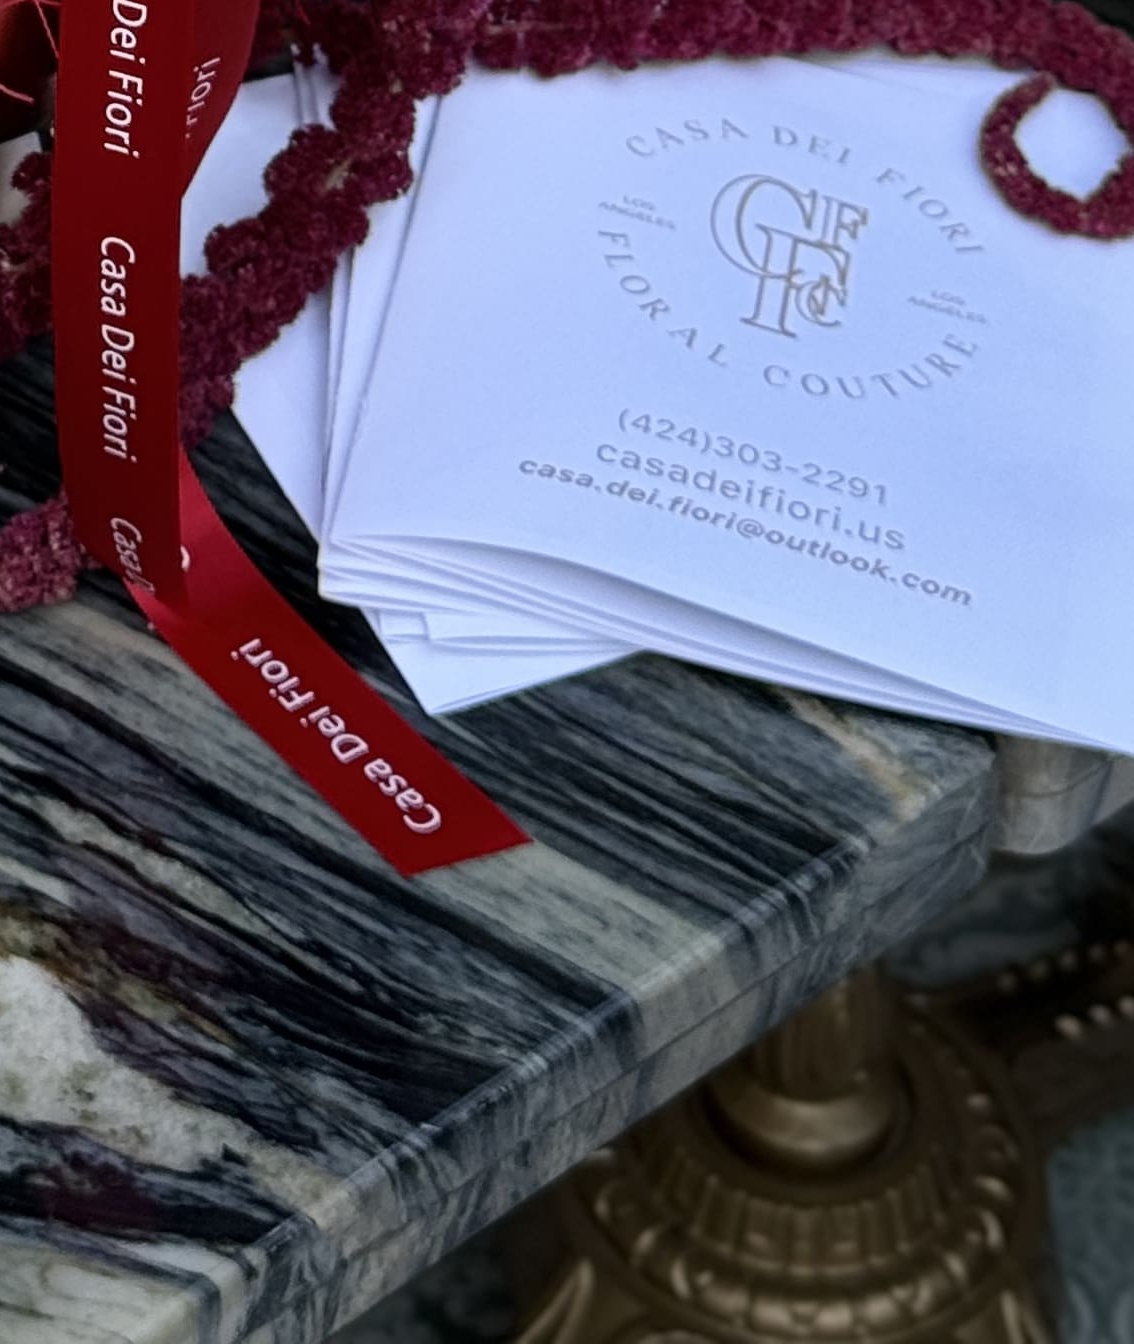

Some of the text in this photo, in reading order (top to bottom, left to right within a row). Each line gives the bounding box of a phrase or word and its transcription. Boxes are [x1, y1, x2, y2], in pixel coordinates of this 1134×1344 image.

[104, 70, 143, 158] Fiori
[624, 116, 984, 253] CASA DEI FIORI
[100, 236, 137, 462] Casa Dei Fiori
[597, 230, 979, 400] FLORAL COUTURE
[595, 443, 906, 551] casadeifiori.us
[618, 408, 887, 505] (424)303-2291
[110, 517, 143, 580] Casa
[517, 459, 972, 606] casa.dei.fiori@outlook.com
[231, 638, 441, 831] Casa Dei Fiori
